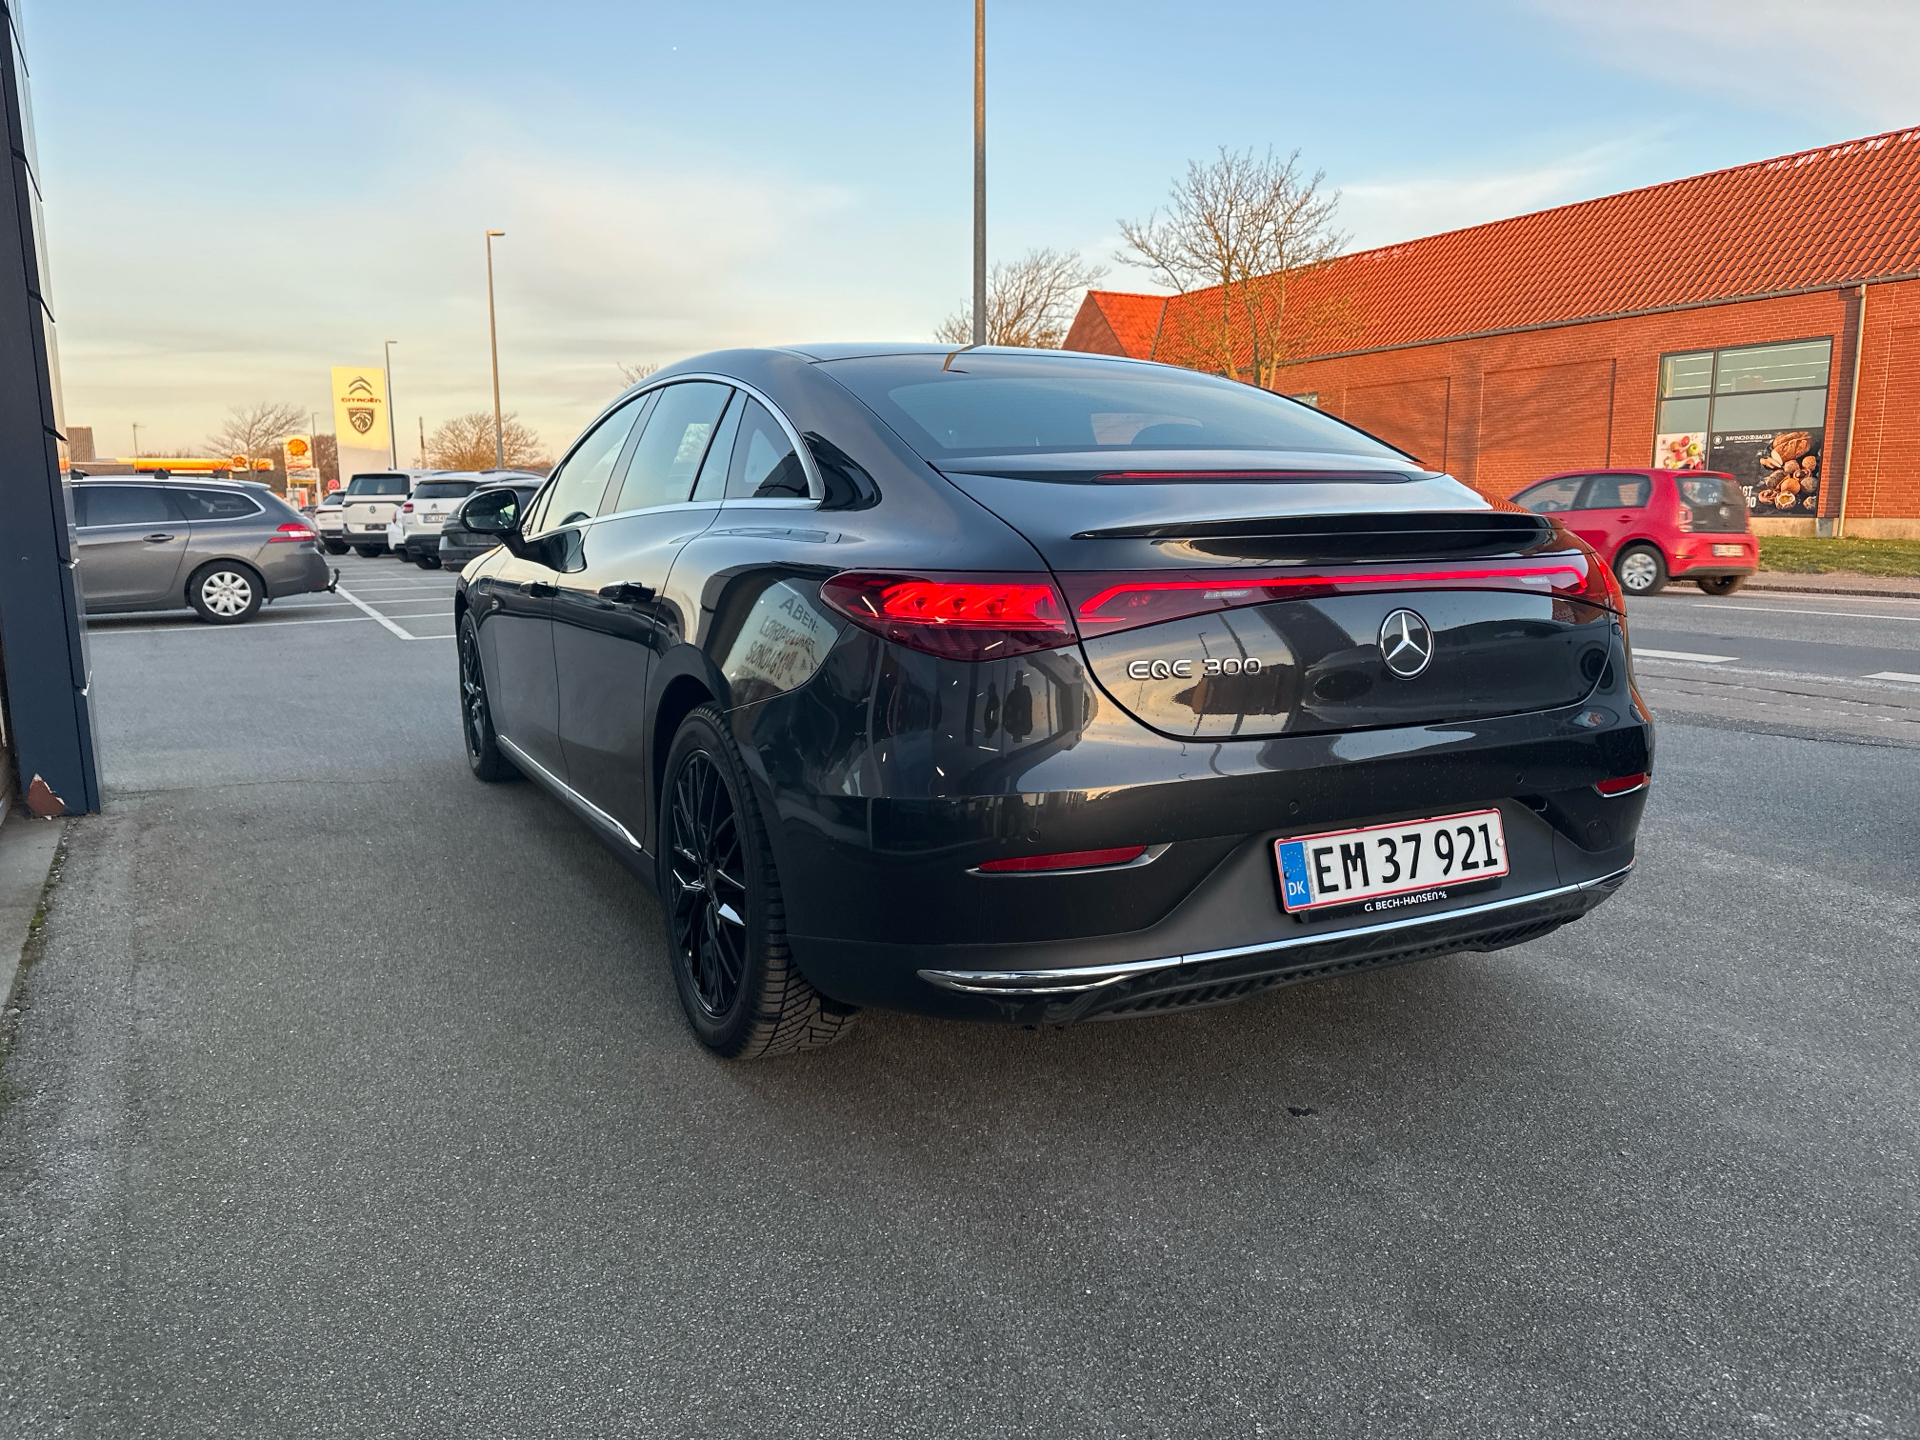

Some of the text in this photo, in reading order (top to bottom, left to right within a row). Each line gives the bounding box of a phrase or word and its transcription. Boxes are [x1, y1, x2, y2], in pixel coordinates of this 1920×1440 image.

[779, 595, 819, 633] ÅBEN:
[1127, 657, 1262, 680] EQE 300
[1312, 822, 1498, 894] EM 37 921
[1288, 880, 1306, 896] DK
[1375, 891, 1439, 911] BECH-HANSEN
